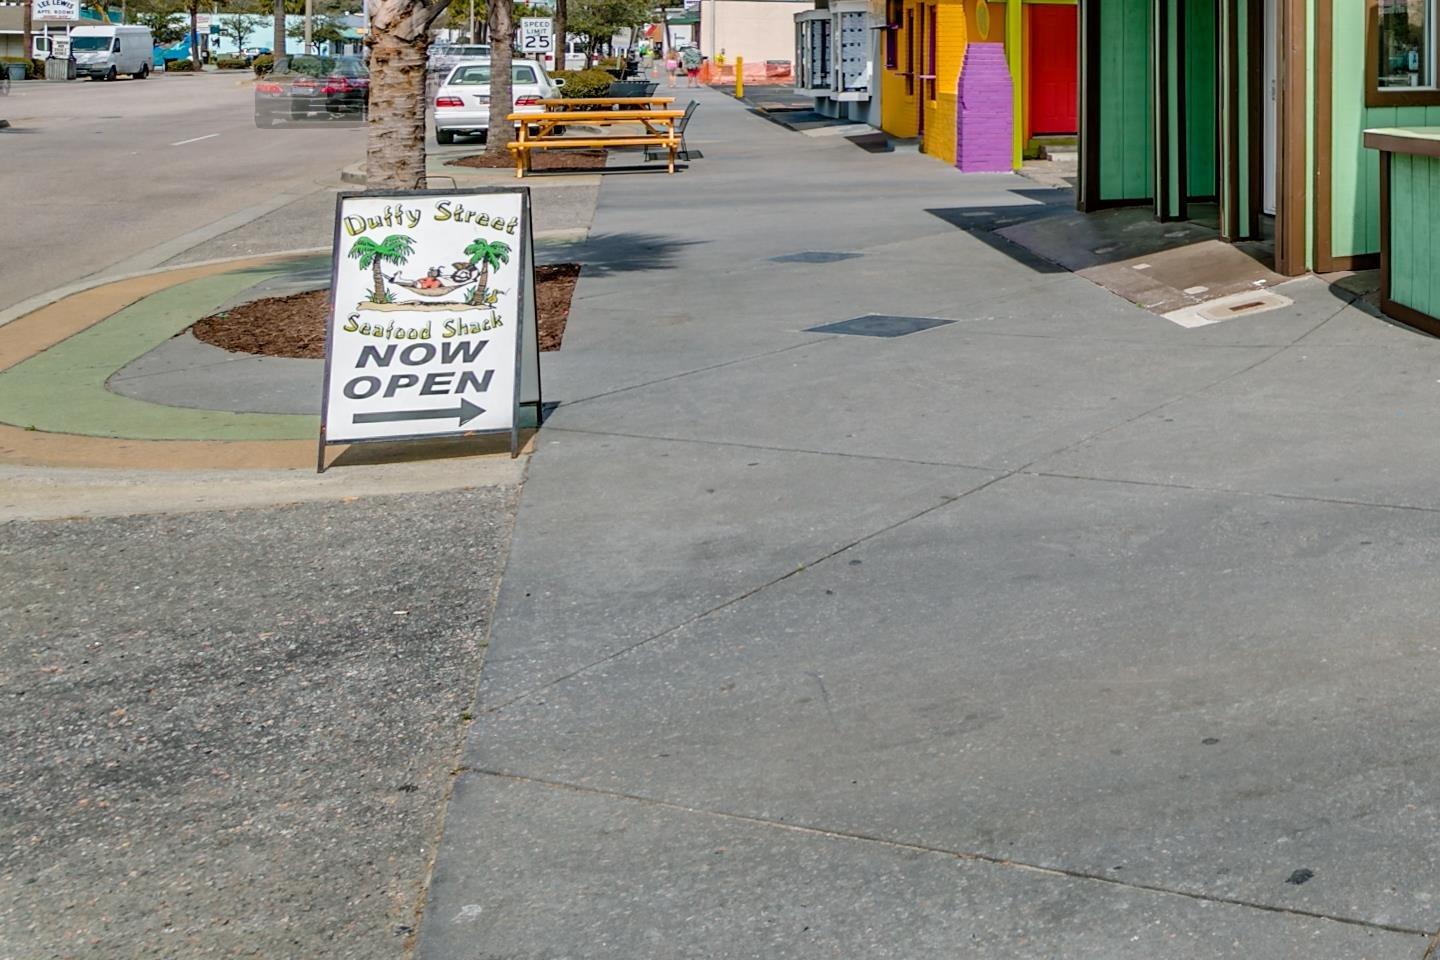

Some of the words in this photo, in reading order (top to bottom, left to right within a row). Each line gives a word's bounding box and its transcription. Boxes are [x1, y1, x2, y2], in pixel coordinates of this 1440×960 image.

[37, 0, 51, 8] LEE
[525, 35, 550, 48] 25
[344, 205, 421, 236] Duffy
[434, 199, 519, 235] Street
[343, 313, 431, 340] Seafood
[442, 310, 503, 339] Shack
[355, 340, 490, 368] NOW
[343, 369, 495, 400] OPEN
